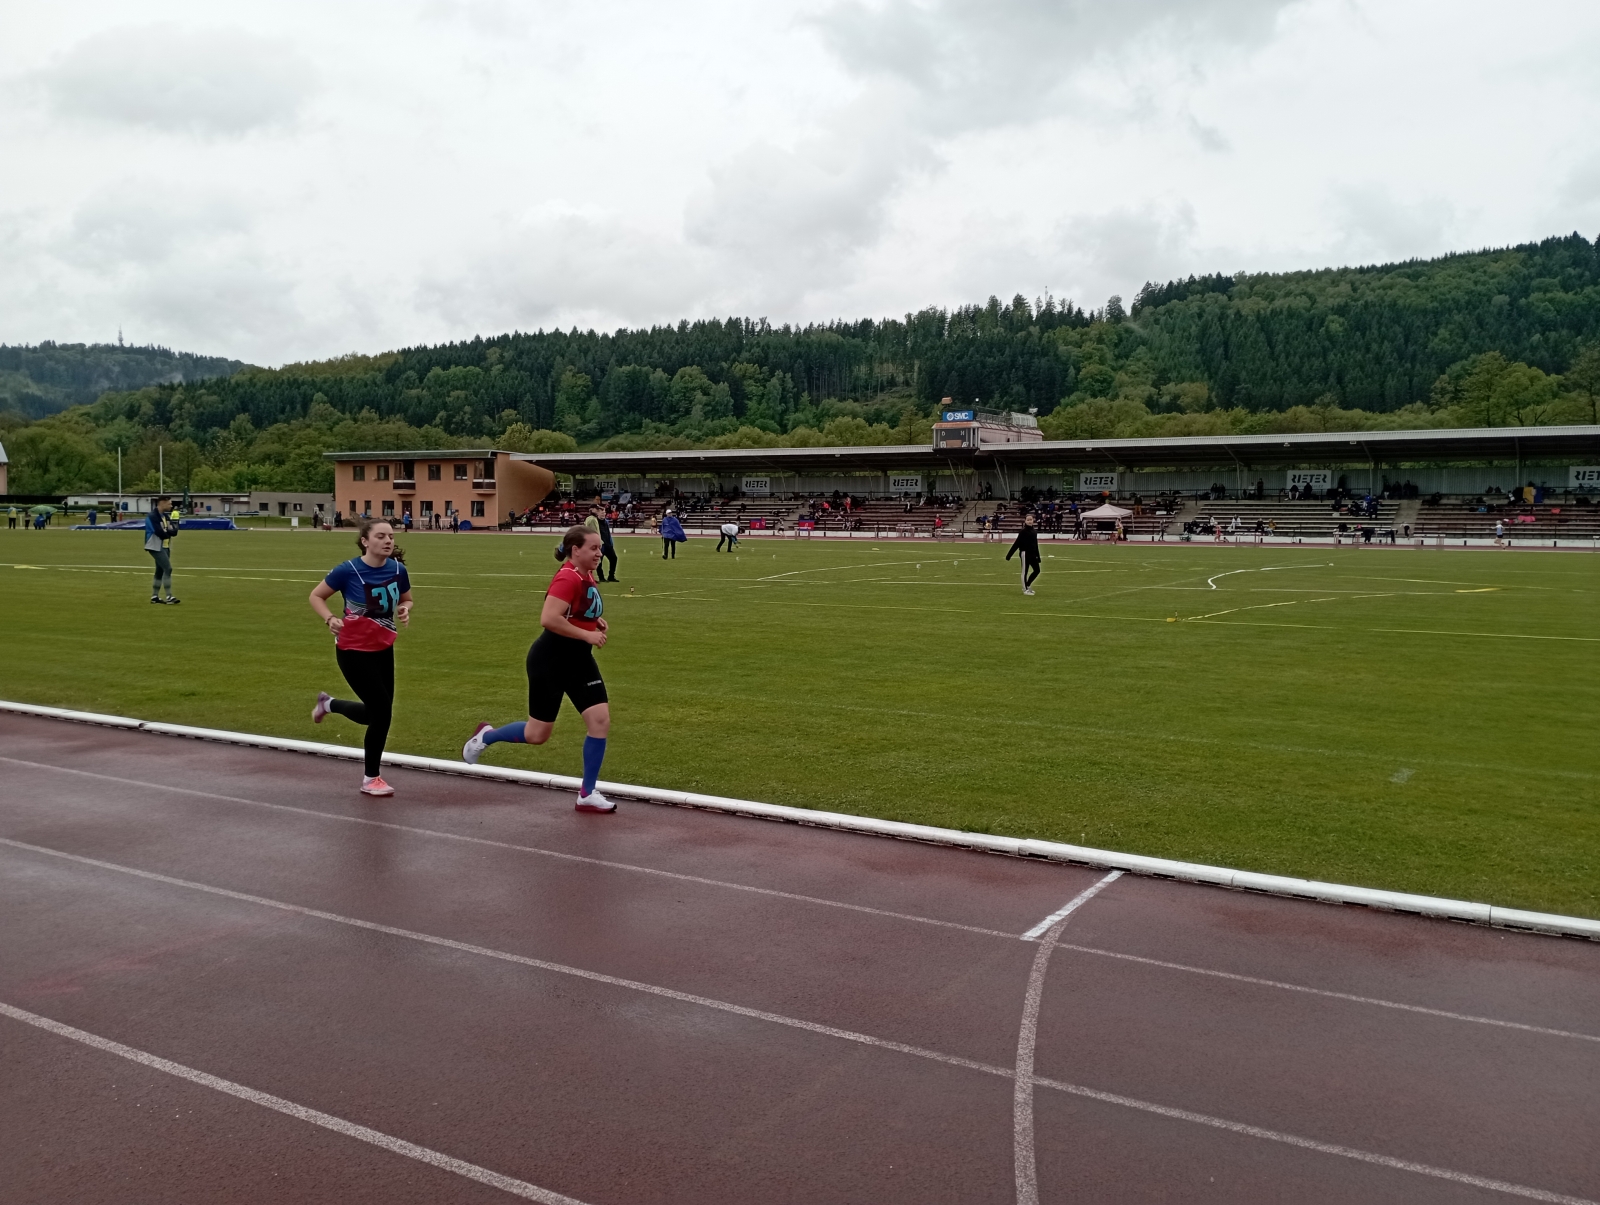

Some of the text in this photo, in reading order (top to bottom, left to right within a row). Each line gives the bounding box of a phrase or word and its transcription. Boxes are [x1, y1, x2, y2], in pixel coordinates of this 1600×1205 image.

[954, 412, 969, 420] SMC
[1084, 477, 1114, 485] RIETER
[1291, 474, 1327, 483] RIETER
[893, 479, 918, 487] RIETER
